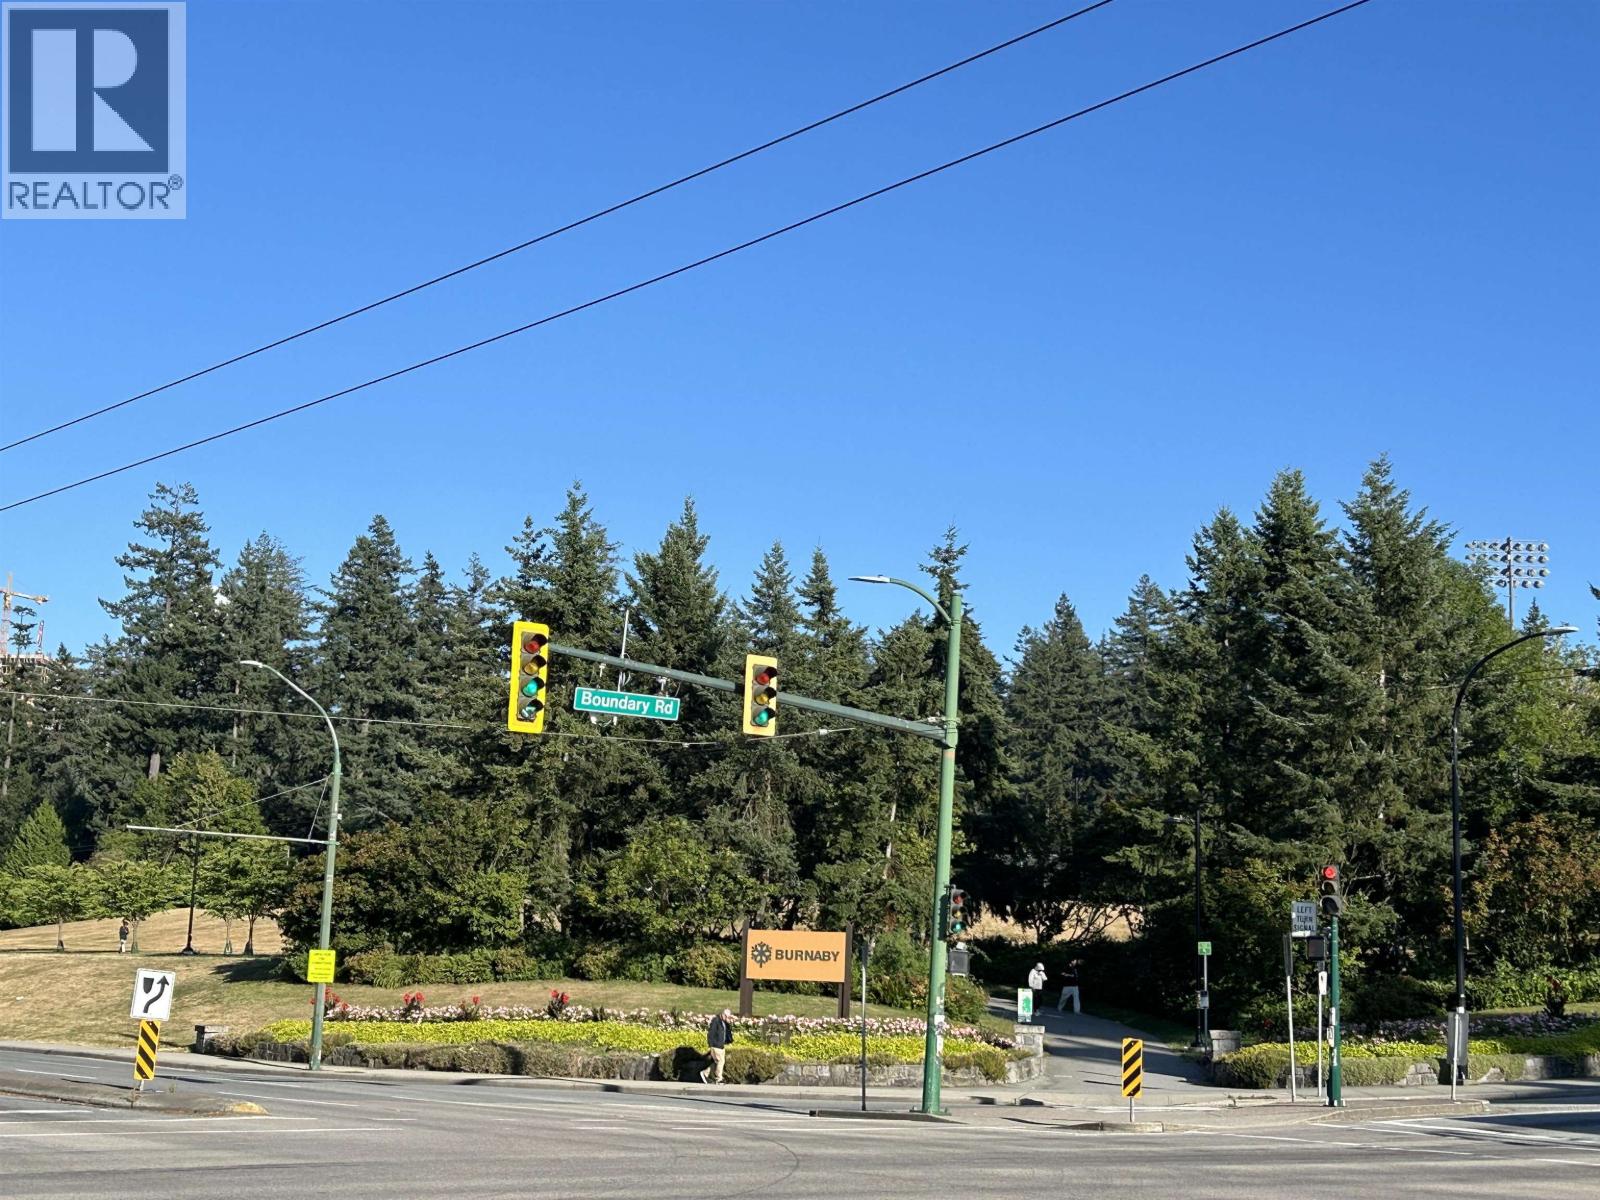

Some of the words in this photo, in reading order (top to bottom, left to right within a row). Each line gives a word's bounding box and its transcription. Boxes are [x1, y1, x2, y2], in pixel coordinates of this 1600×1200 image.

[581, 691, 650, 714] Boundary
[655, 700, 674, 715] Rd
[1296, 905, 1313, 914] LEFT
[775, 949, 840, 962] BURNABY
